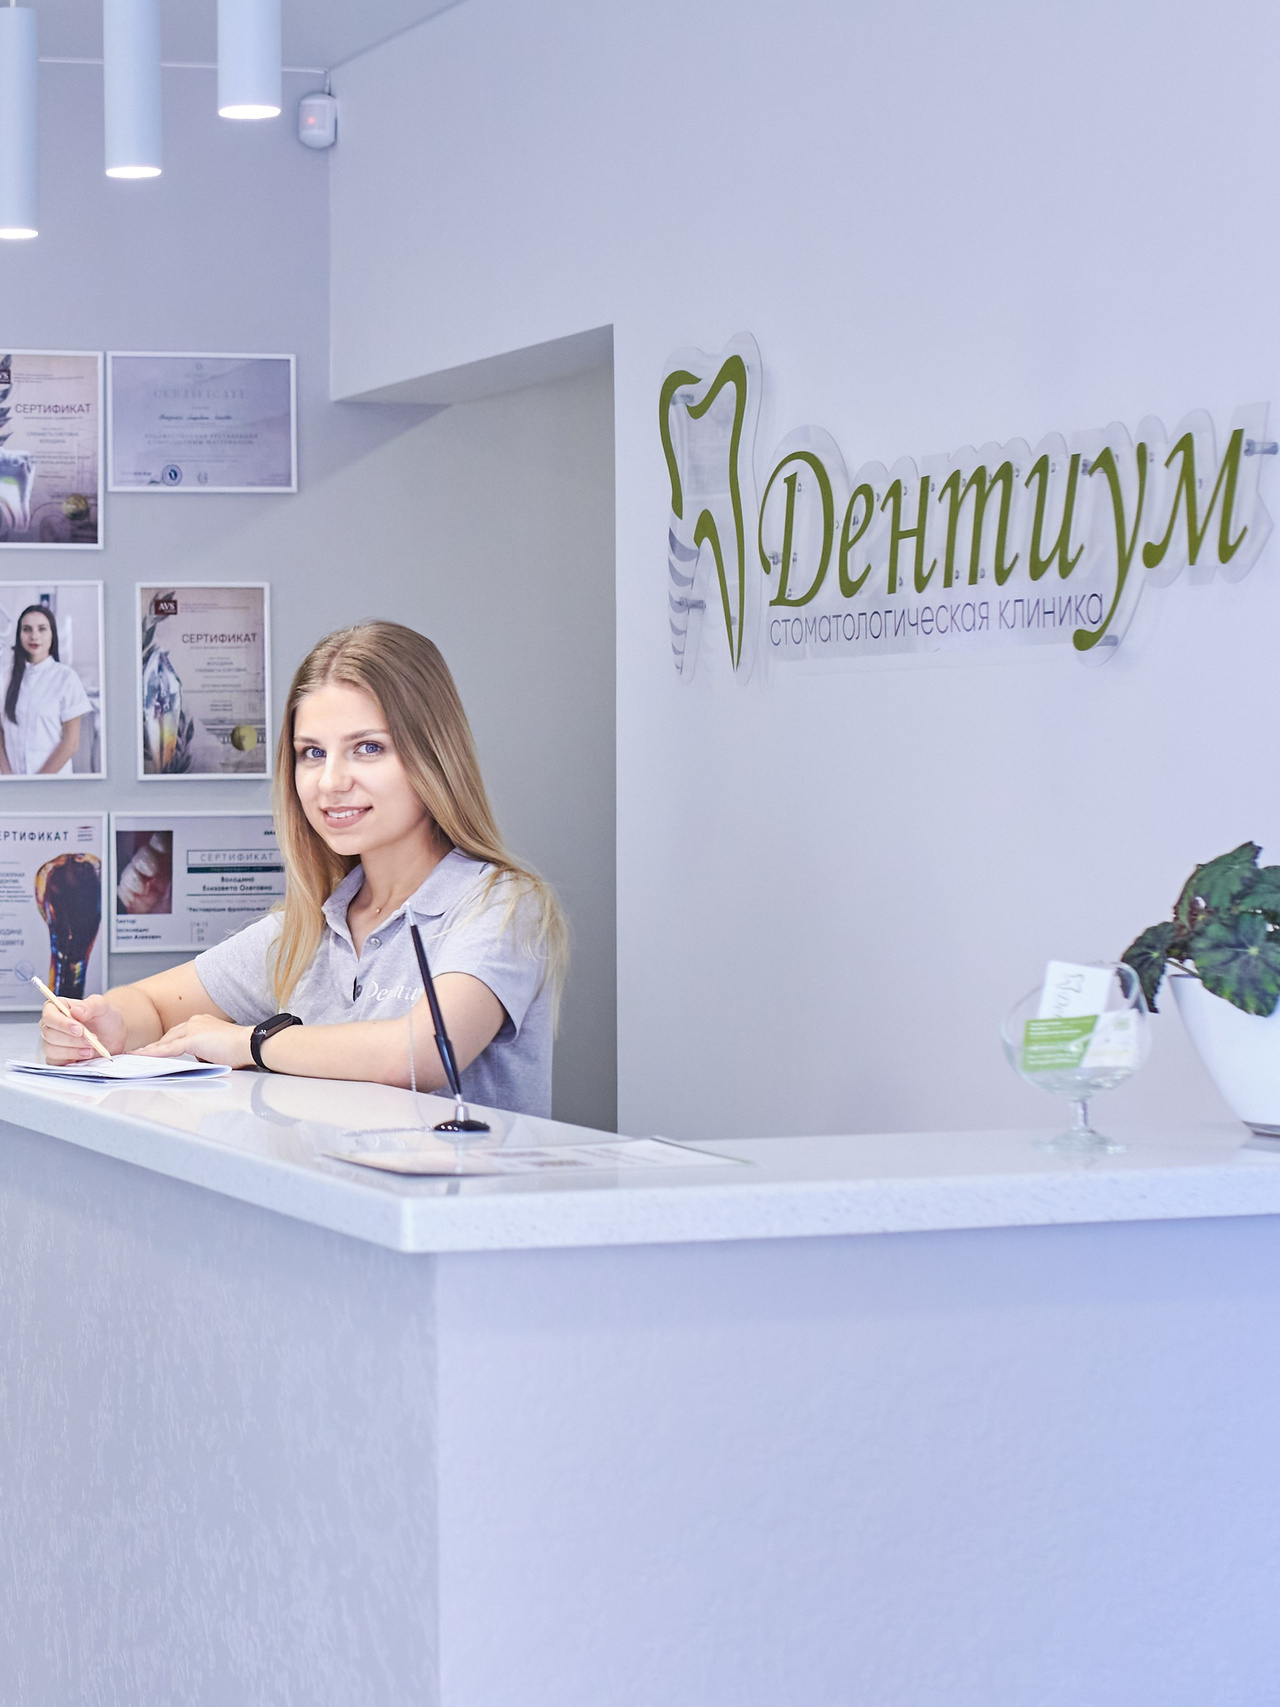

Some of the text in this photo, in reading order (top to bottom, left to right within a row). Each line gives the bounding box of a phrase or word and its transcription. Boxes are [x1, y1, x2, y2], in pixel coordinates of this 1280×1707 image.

[15, 403, 92, 414] СЕРТИФИКАТ
[758, 428, 1248, 651] Дентиум
[158, 602, 176, 611] AVS
[770, 593, 1104, 647] стоматологическая клиника
[181, 633, 258, 644] СЕРТИФИКАТ
[200, 852, 275, 862] СЕРТИФИКАТ
[239, 884, 273, 892] Олеговна
